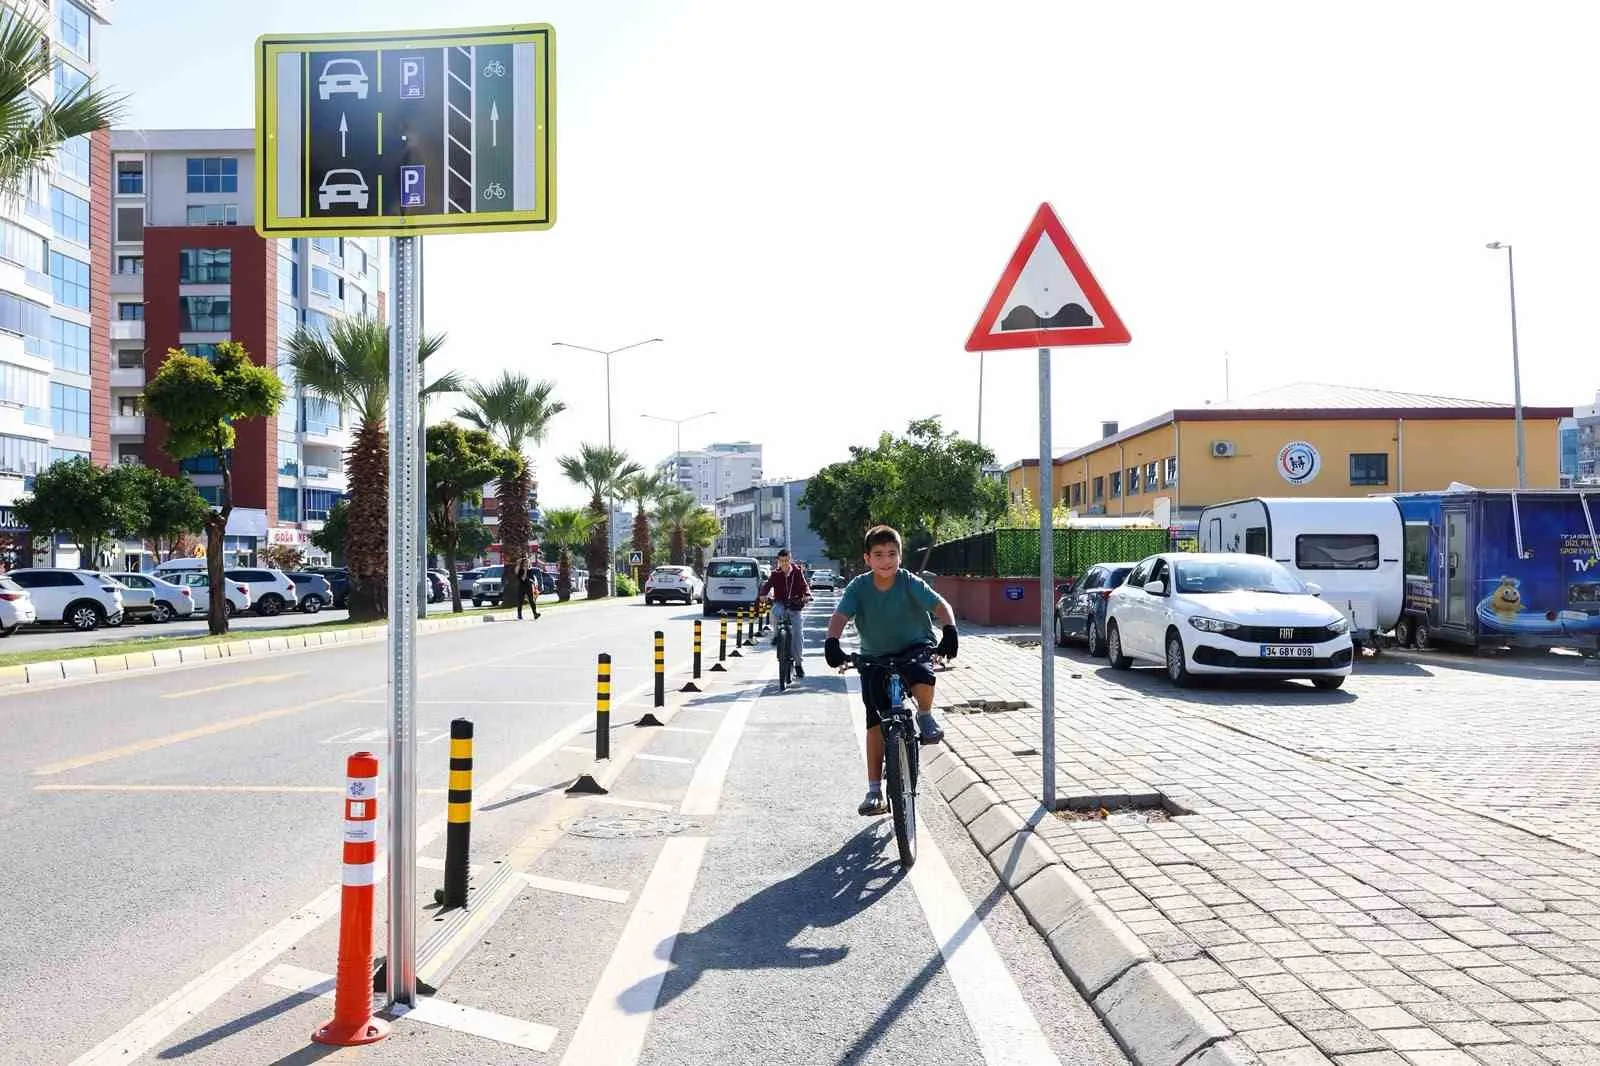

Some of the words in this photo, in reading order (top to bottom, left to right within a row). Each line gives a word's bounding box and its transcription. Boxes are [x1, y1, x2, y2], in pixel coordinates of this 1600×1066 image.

[403, 62, 418, 85] P
[405, 170, 419, 193] P
[1279, 627, 1295, 639] FIAT
[1266, 647, 1277, 656] 34
[1279, 647, 1295, 656] GBY
[1297, 647, 1312, 656] 099
